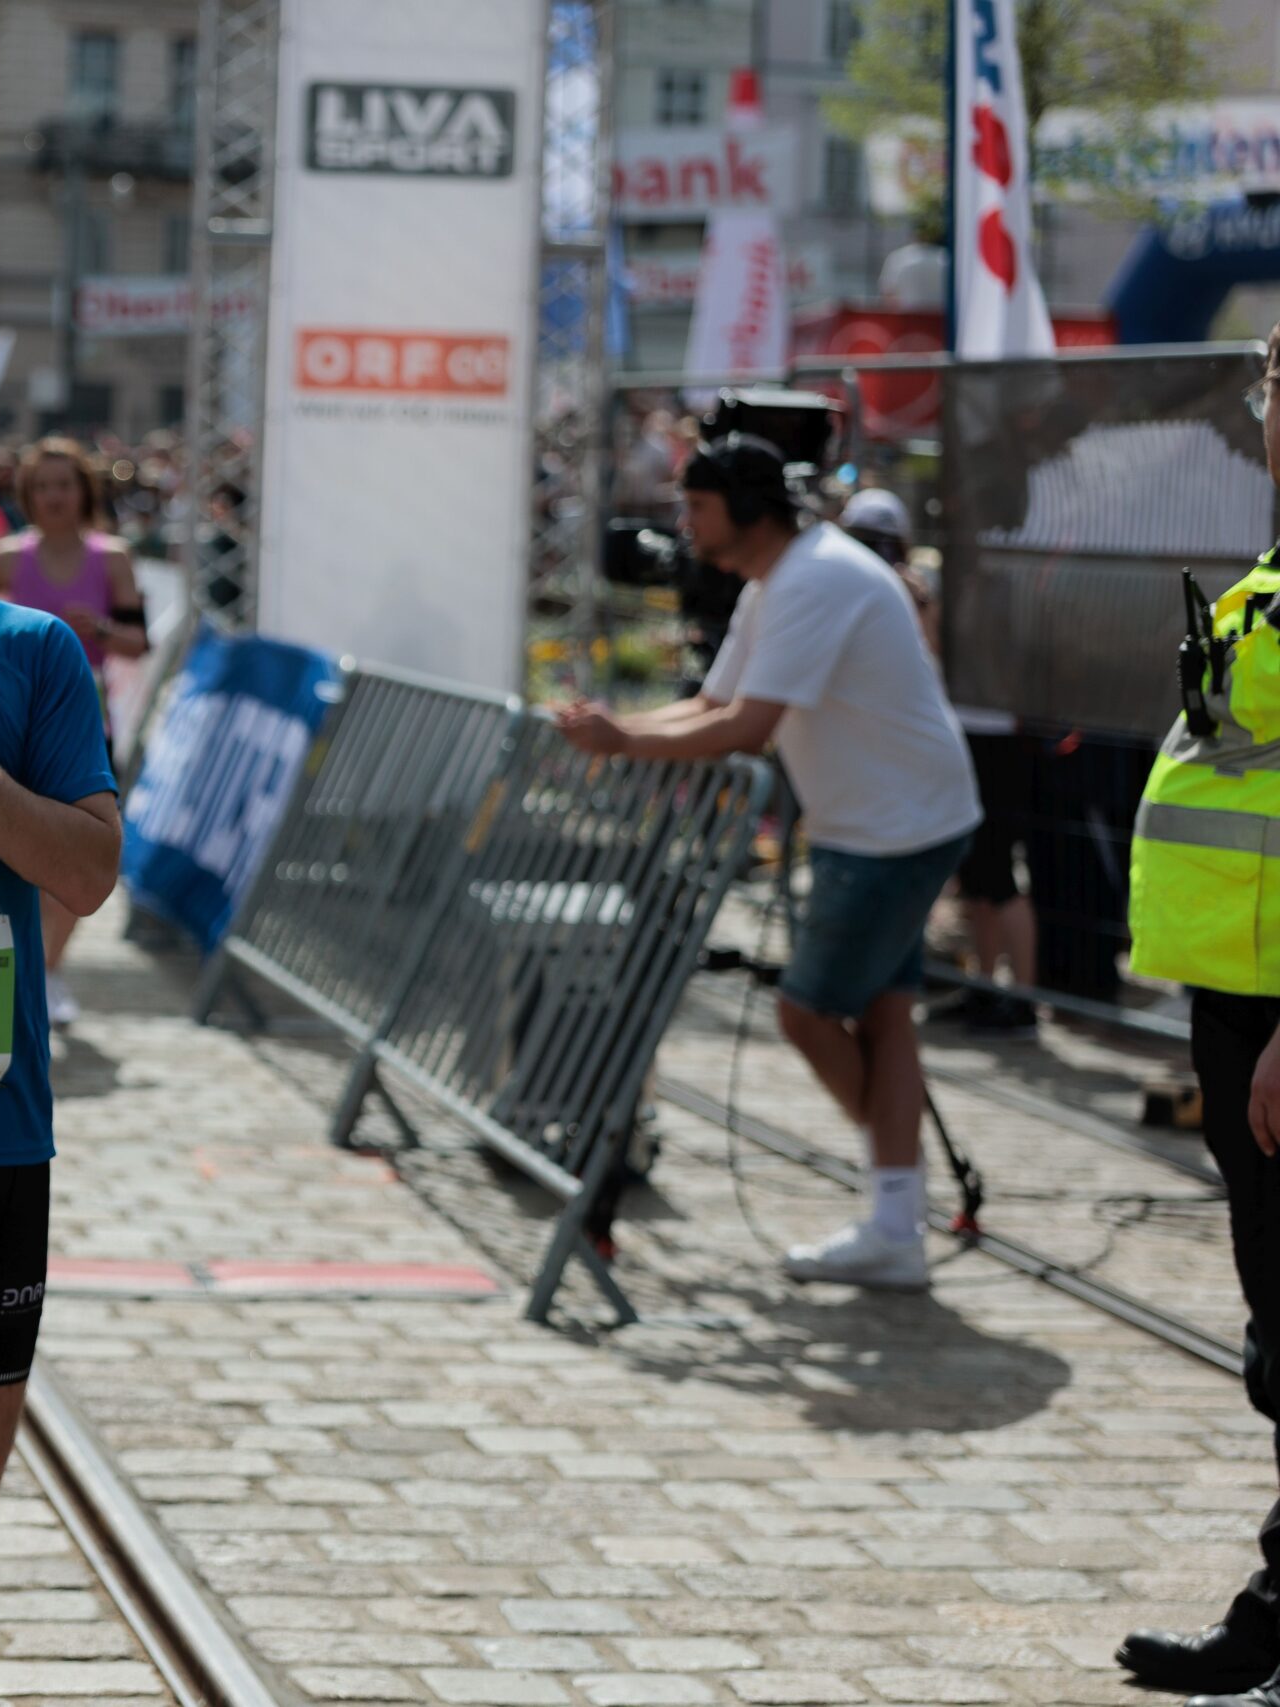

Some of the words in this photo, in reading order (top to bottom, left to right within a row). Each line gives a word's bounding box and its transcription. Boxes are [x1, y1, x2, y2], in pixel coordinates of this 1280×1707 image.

[318, 88, 506, 139] LIVA
[319, 139, 505, 173] SPORT
[304, 336, 440, 385] ORF
